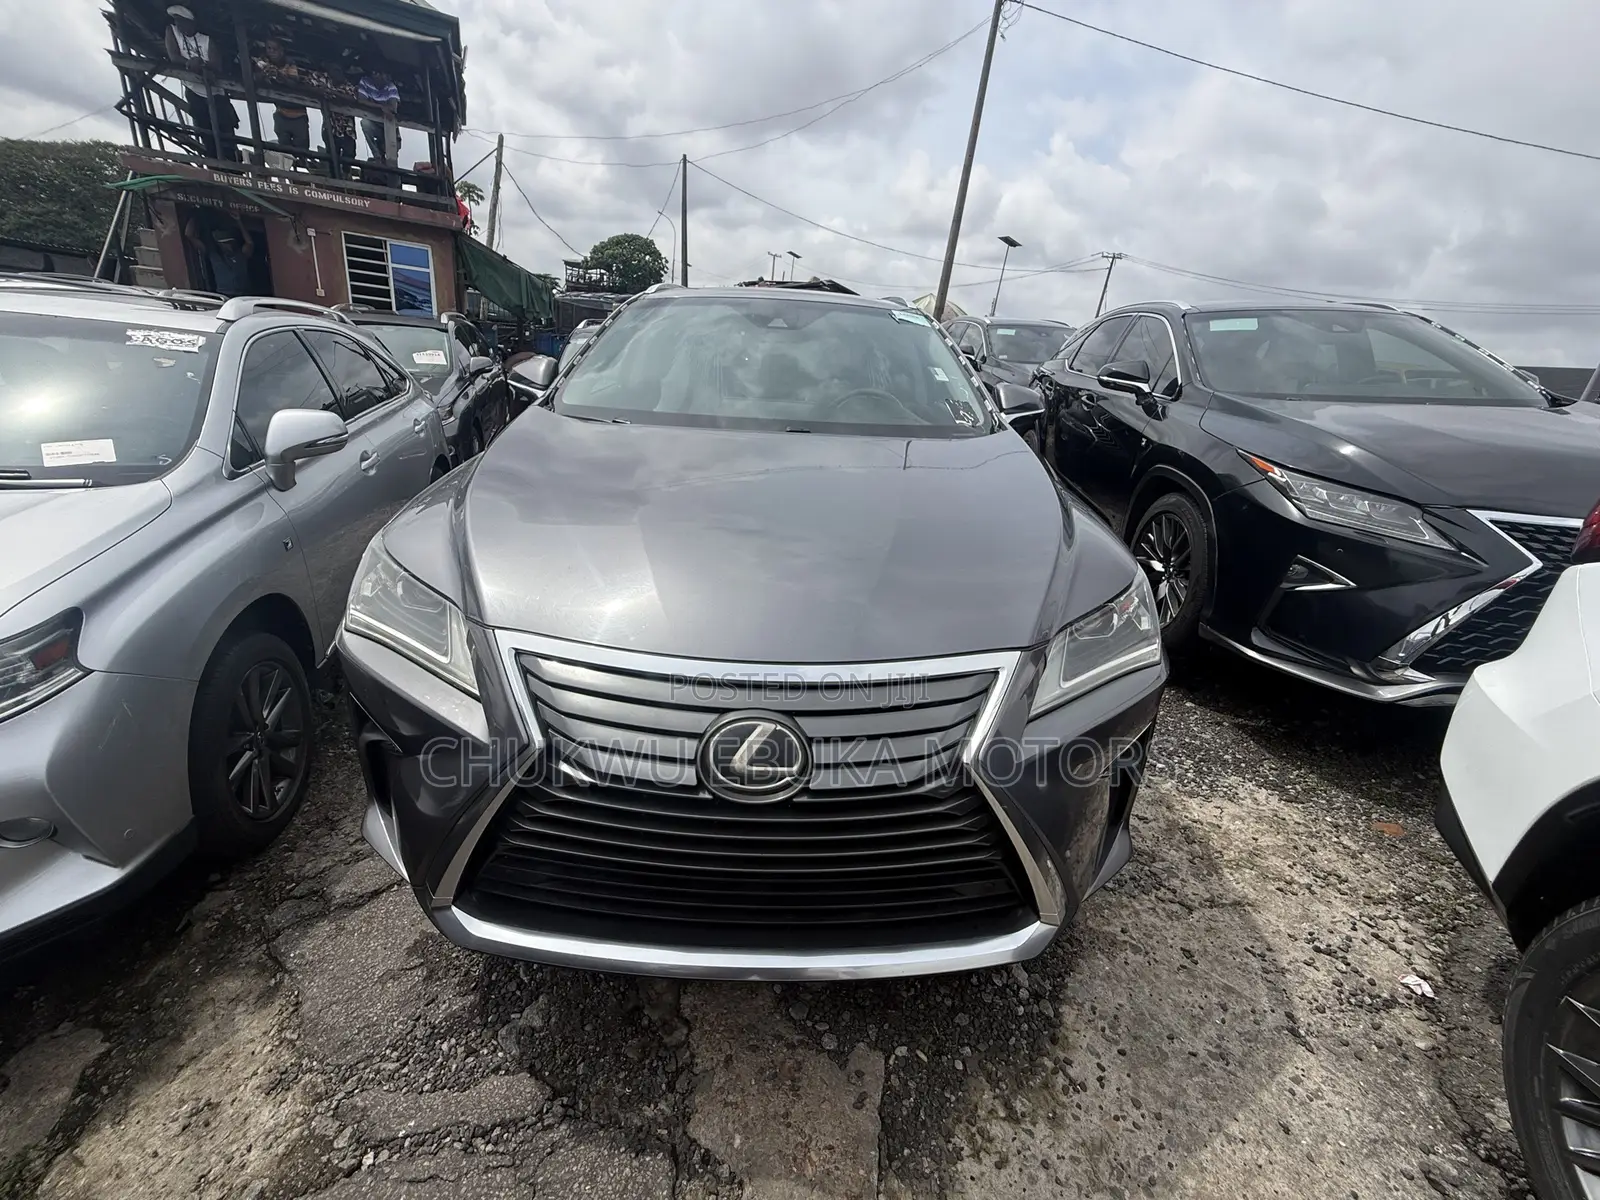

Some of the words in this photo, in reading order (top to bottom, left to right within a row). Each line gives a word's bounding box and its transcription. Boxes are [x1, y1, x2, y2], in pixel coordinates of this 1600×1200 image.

[213, 173, 253, 187] BUYERS
[258, 181, 283, 193] FEES
[289, 186, 299, 195] IS
[304, 189, 371, 208] COMPULSORY
